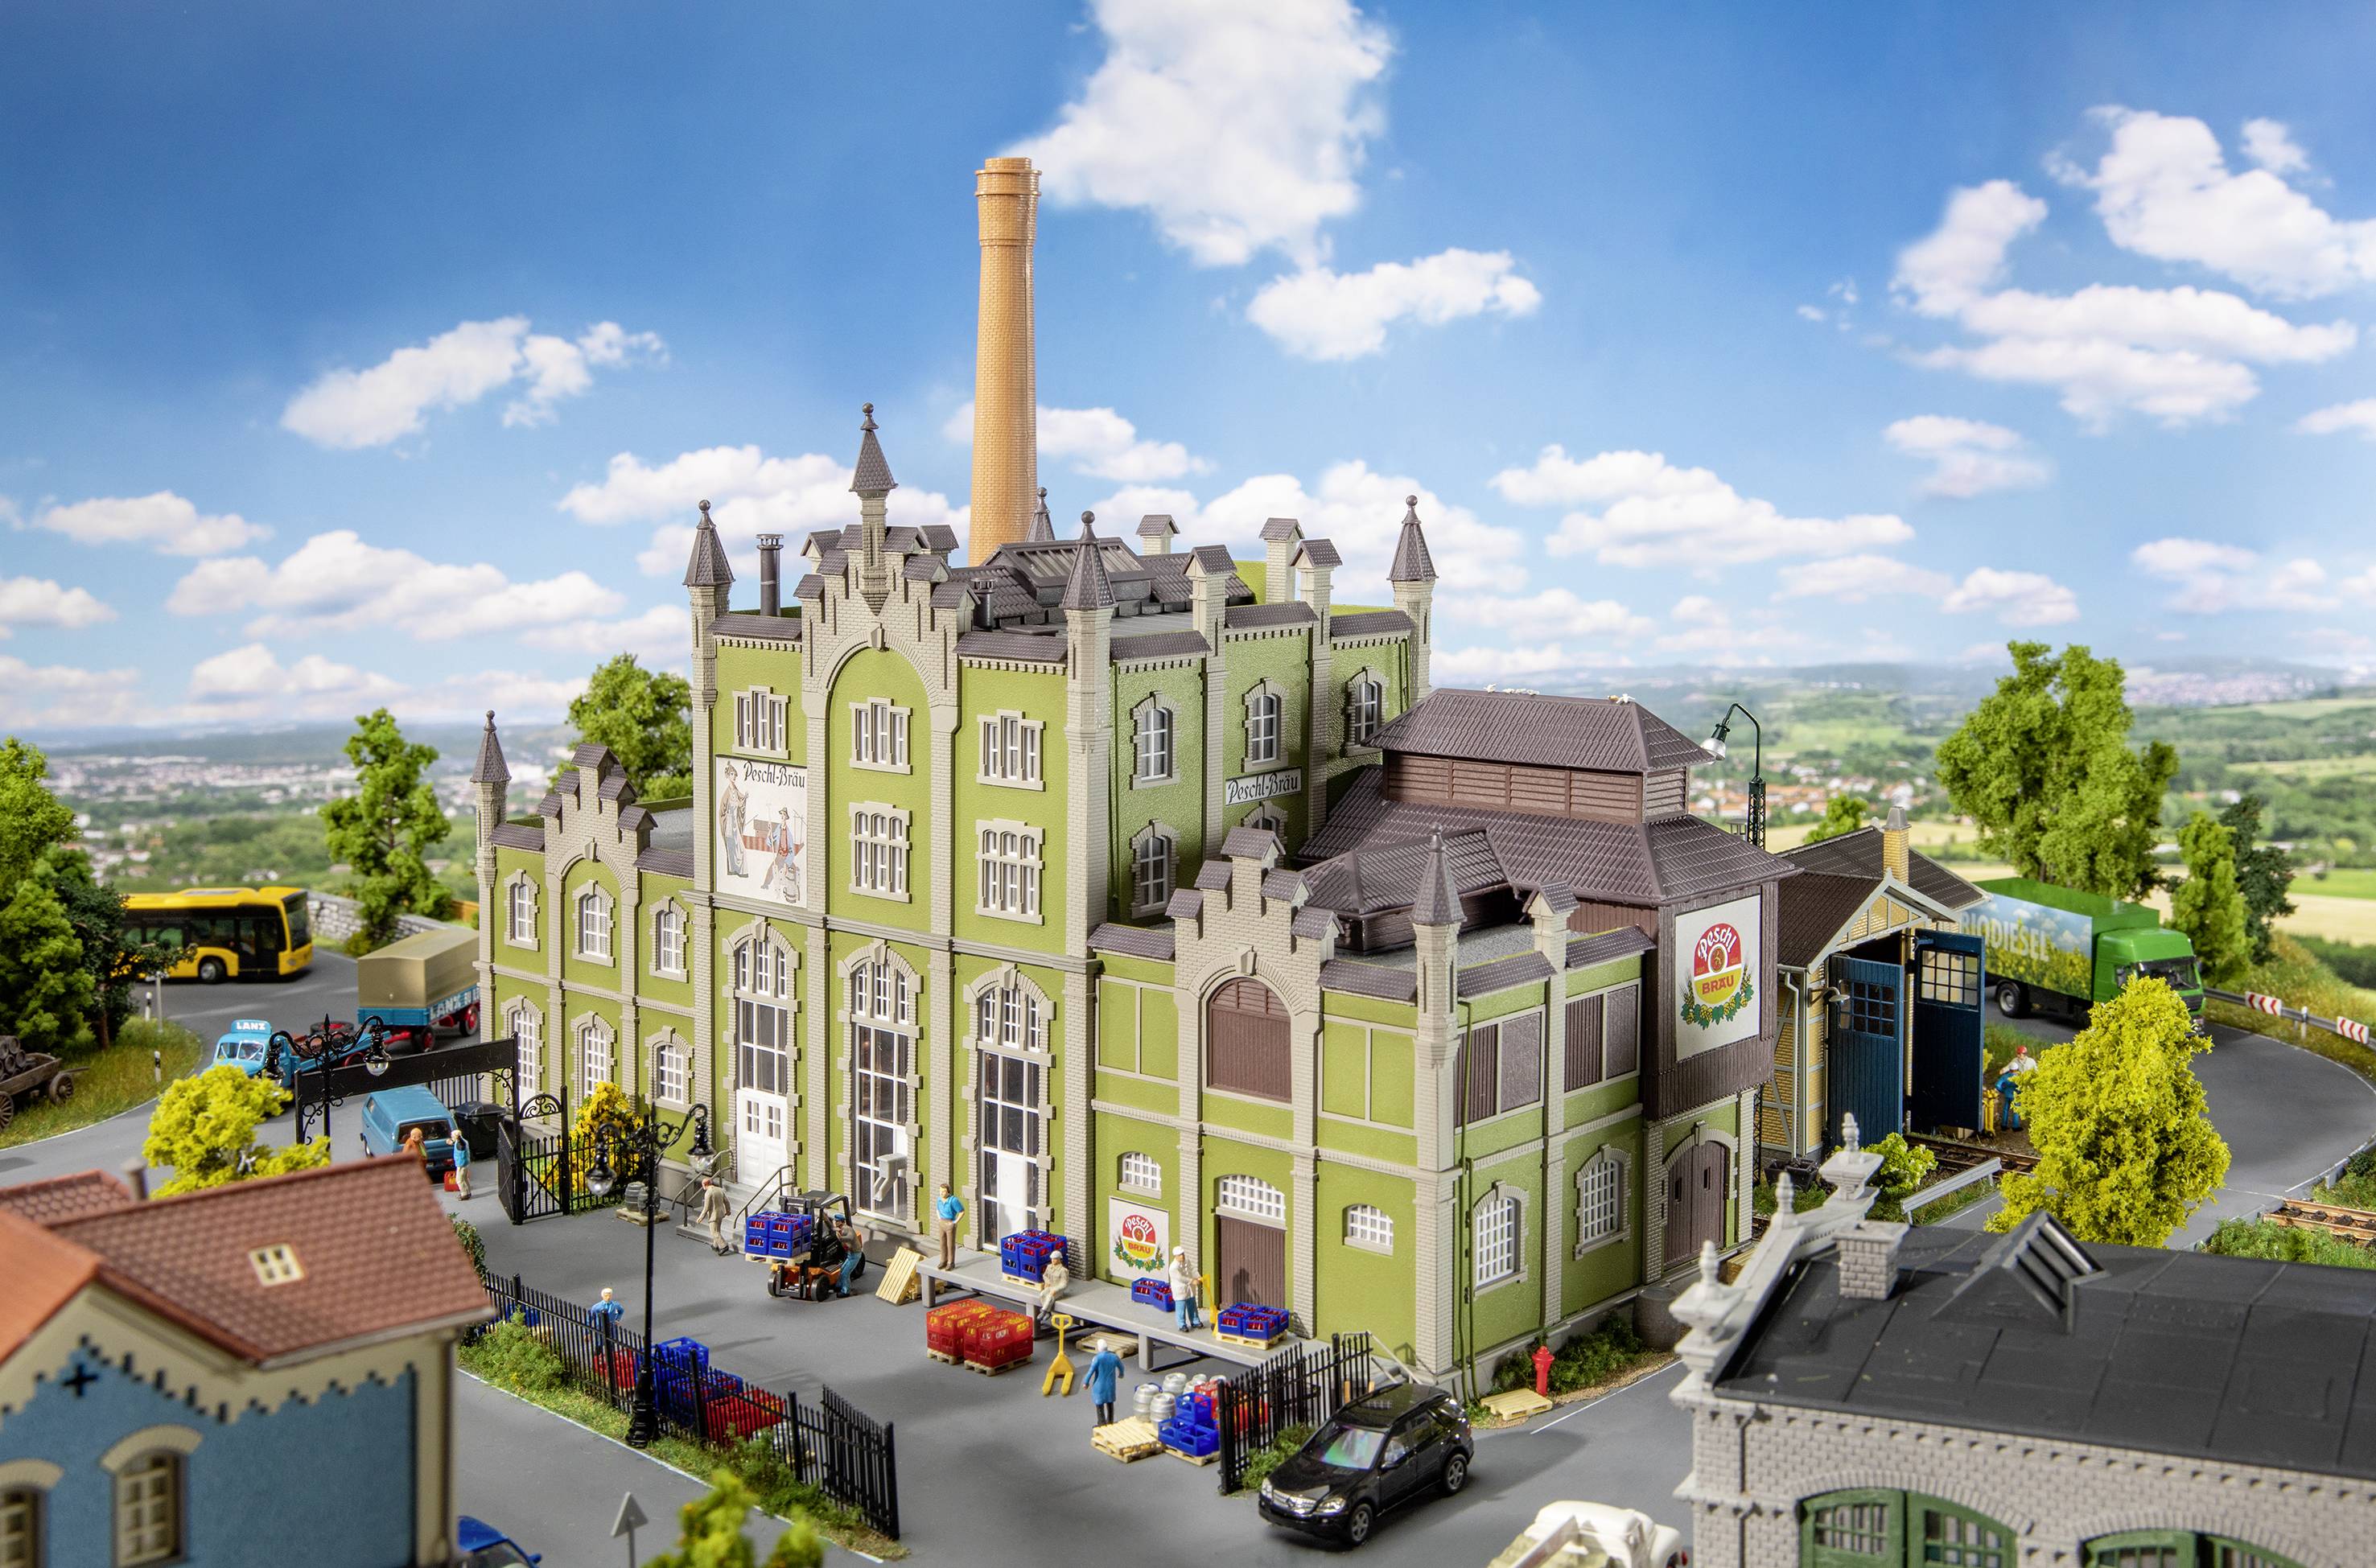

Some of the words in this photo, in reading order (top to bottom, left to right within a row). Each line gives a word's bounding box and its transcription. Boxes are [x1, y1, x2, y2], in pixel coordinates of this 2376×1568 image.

[743, 762, 805, 788] Peschl-Bräu
[1228, 773, 1298, 804] Peschl-Bräu
[1698, 927, 1737, 961] Peschl
[1962, 912, 2049, 961] BIODIESEL
[1703, 975, 1734, 994] BRÄU
[237, 1022, 266, 1031] LANZ
[1126, 1216, 1152, 1234] Peschl
